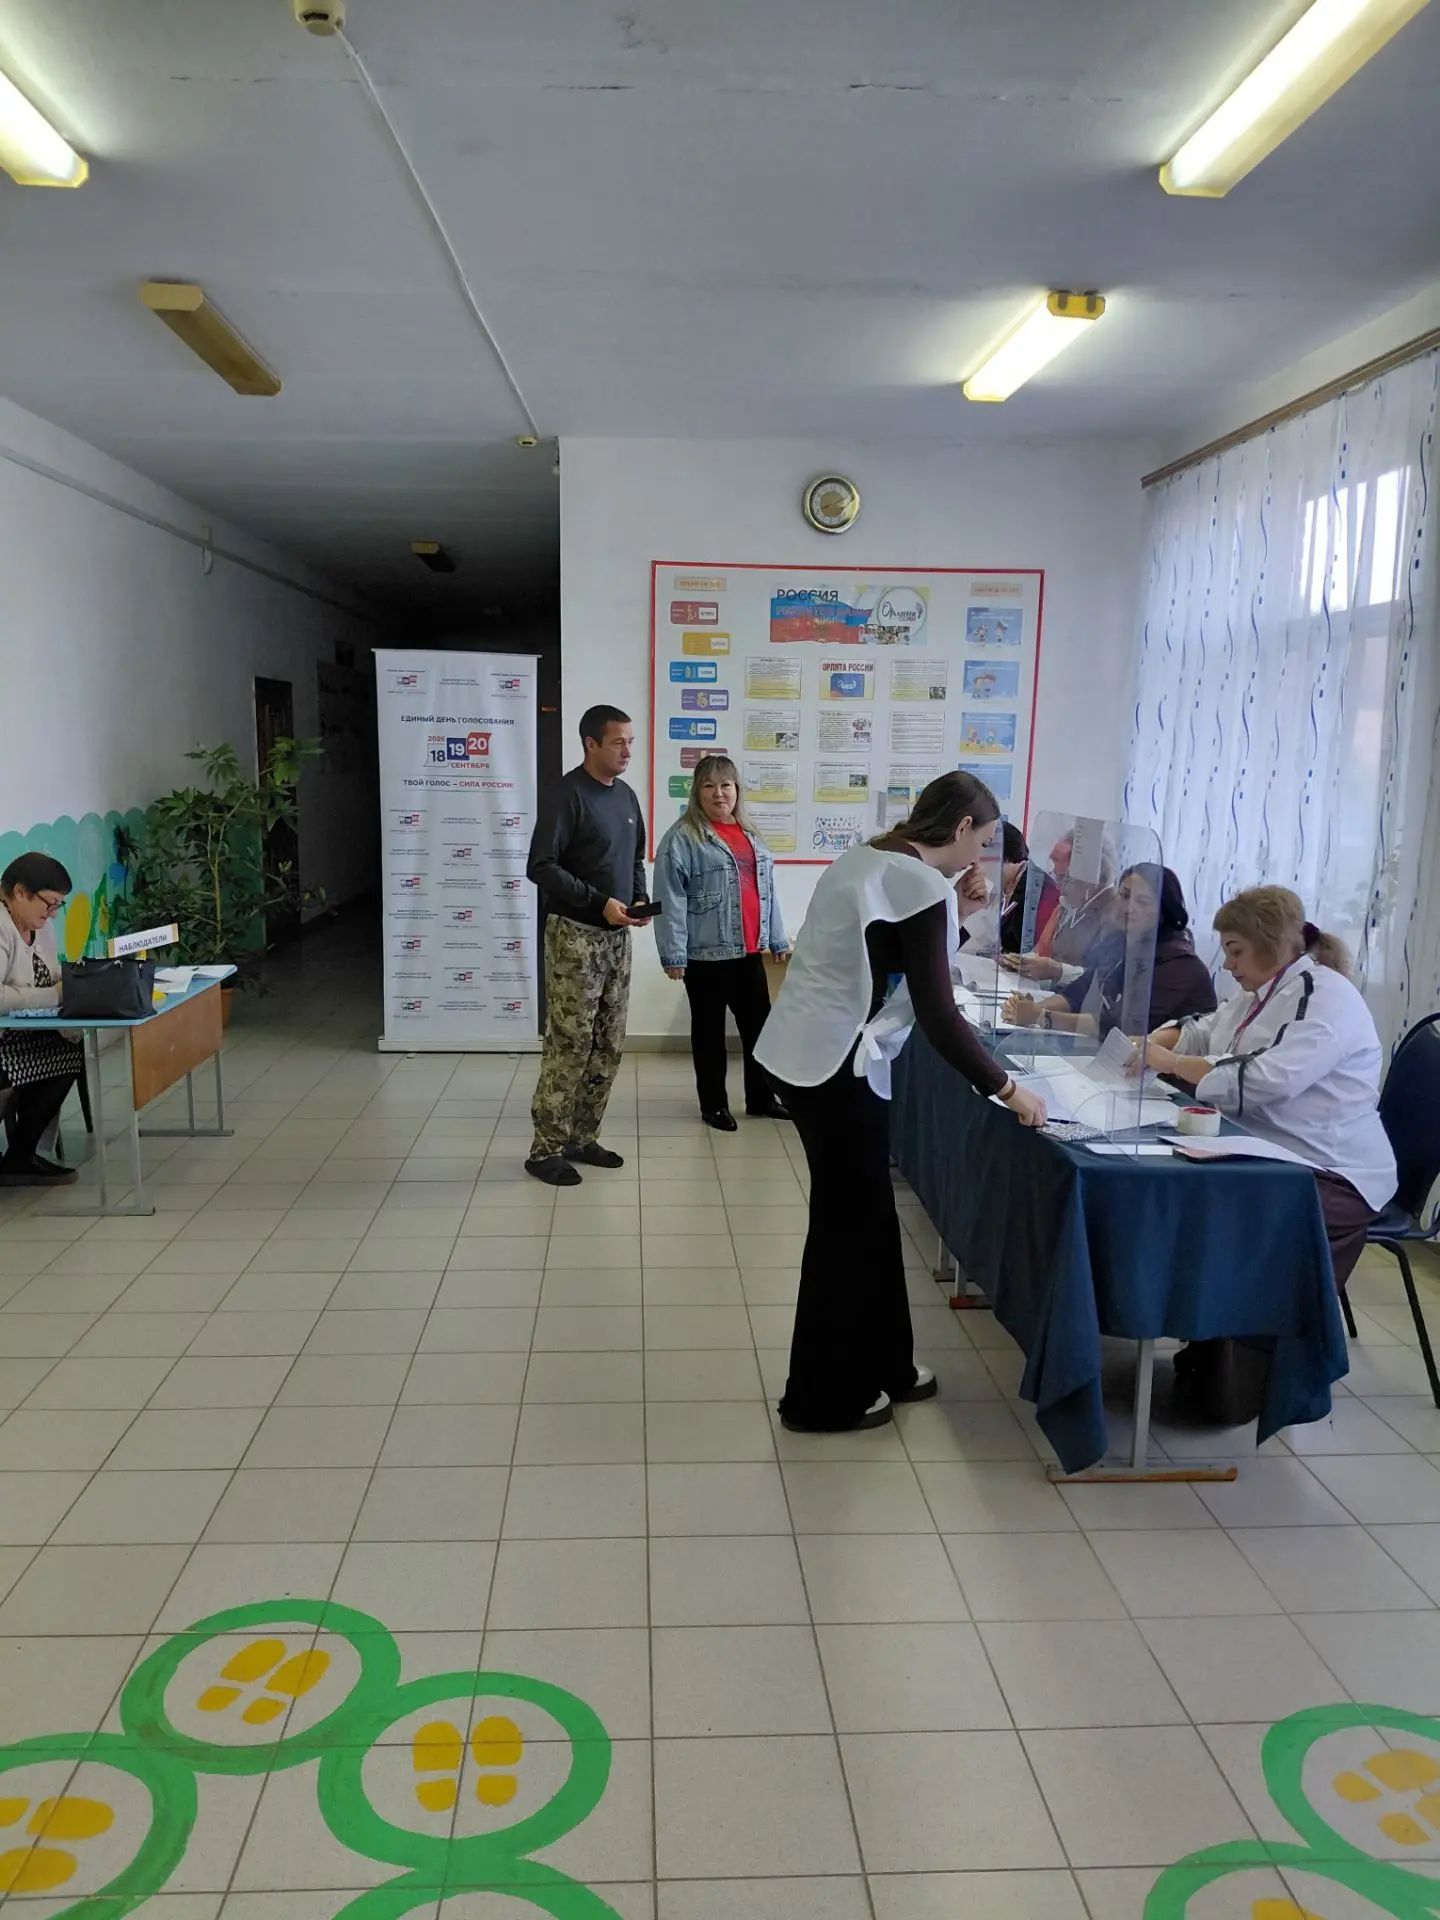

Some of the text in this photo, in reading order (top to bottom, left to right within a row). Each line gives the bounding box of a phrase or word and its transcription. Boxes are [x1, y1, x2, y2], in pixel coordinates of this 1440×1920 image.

[777, 589, 838, 602] РОССИЯ
[822, 663, 873, 672] ОРЛЯТА РОССИИ
[400, 715, 434, 723] ЕДИНЫЙ
[458, 717, 514, 725] ГОЛОСОВАНИЯ
[430, 737, 487, 762] 18 19 20
[403, 778, 424, 786] ТВОЙ
[425, 779, 451, 787] ГОЛОС
[118, 934, 167, 952] НАБЛЮДАТЕЛИ
